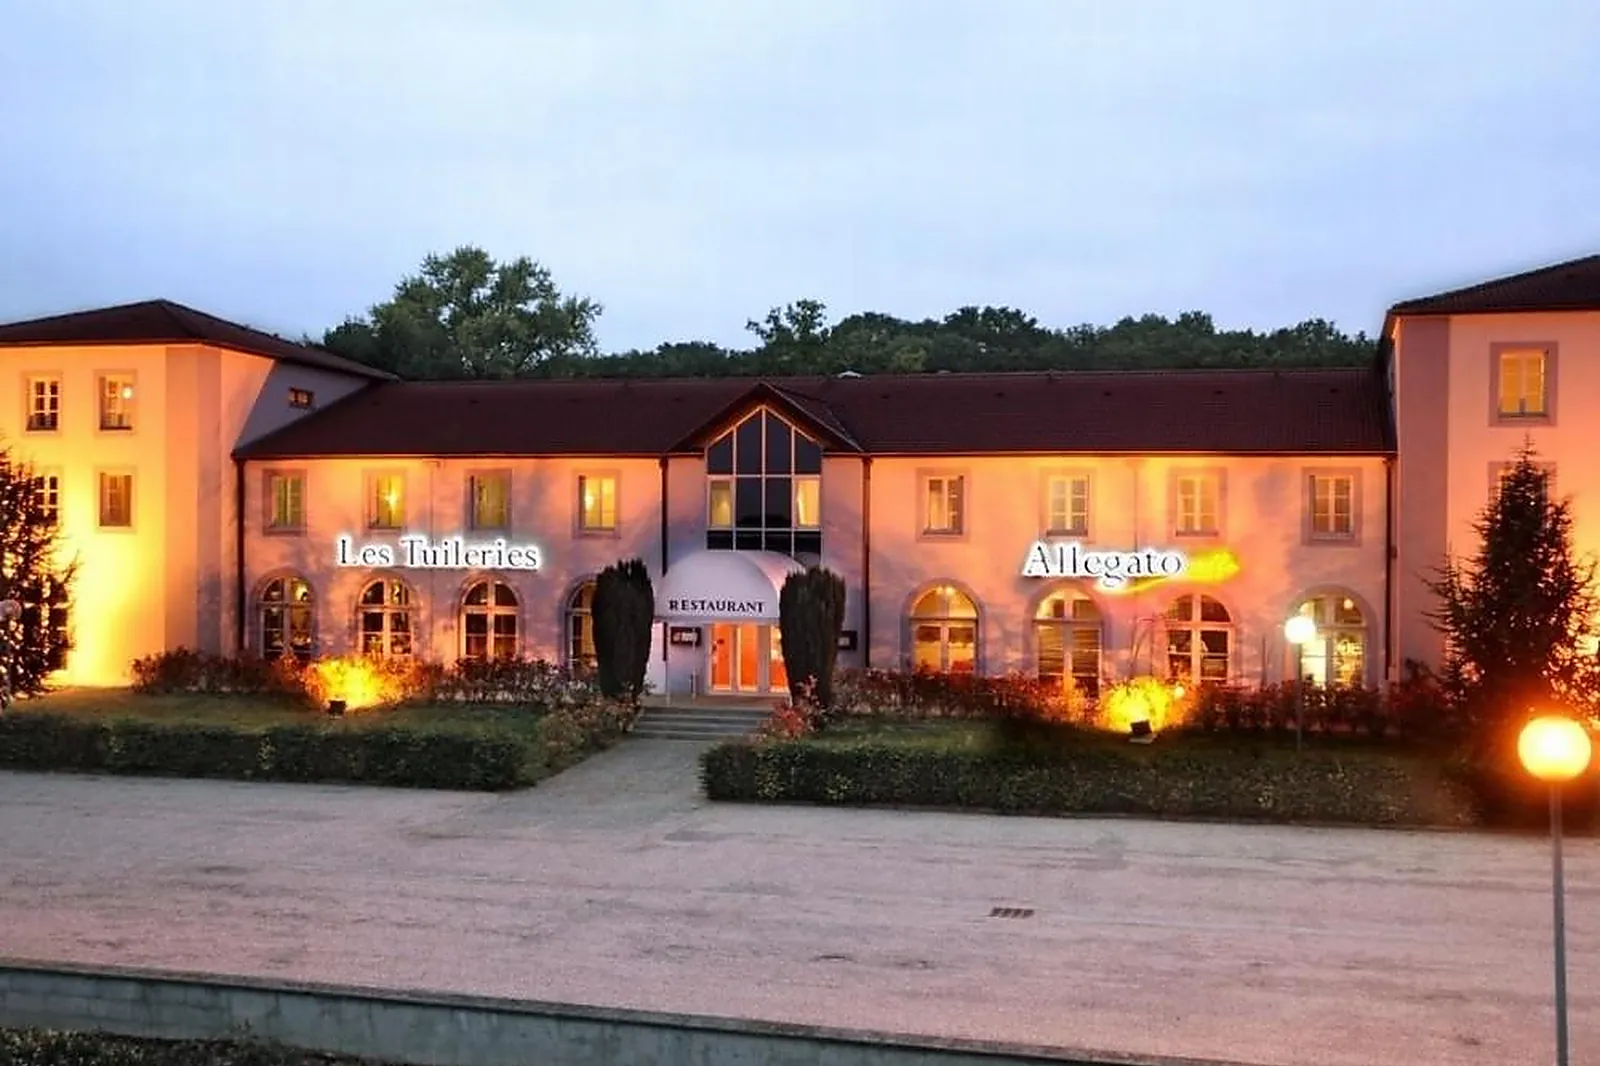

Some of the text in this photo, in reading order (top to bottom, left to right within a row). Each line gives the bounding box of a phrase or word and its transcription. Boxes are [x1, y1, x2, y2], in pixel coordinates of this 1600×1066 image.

[338, 537, 539, 568] Les Tuileries
[1024, 543, 1184, 588] Allegato
[668, 599, 764, 614] RESTAURANT
